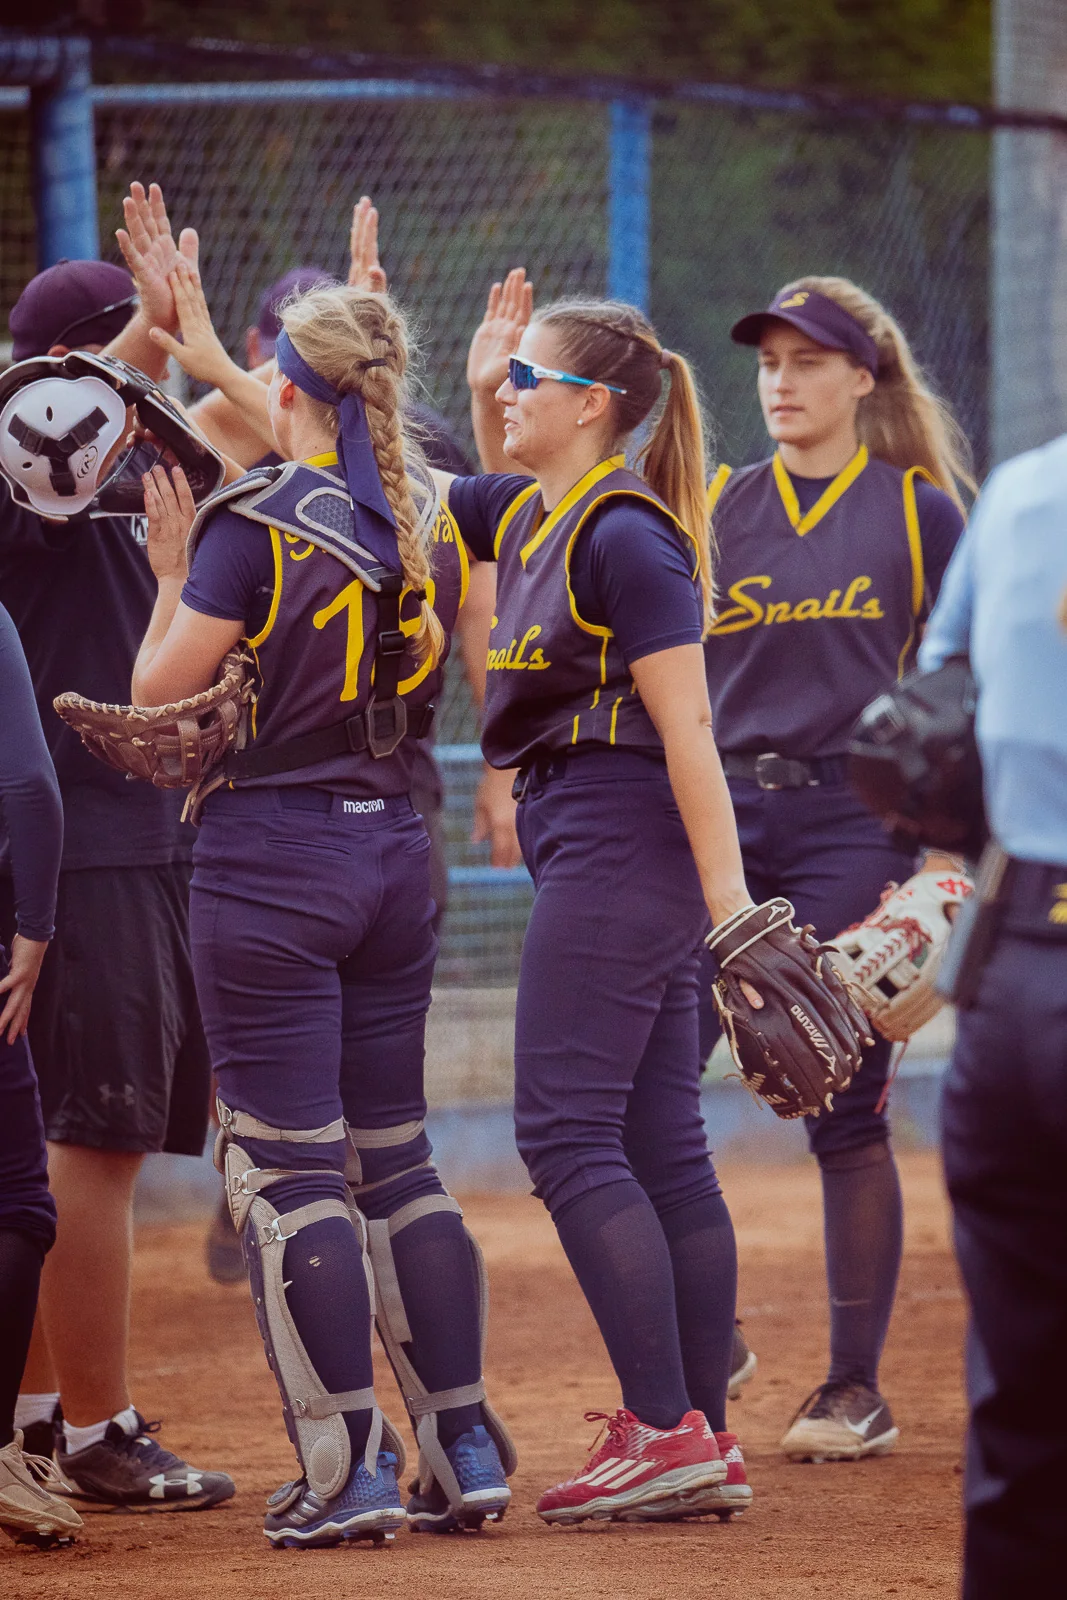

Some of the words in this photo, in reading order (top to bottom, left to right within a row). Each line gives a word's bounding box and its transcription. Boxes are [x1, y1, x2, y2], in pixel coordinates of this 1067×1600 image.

[708, 574, 885, 636] Snails
[486, 615, 552, 671] nails
[343, 798, 385, 814] macron
